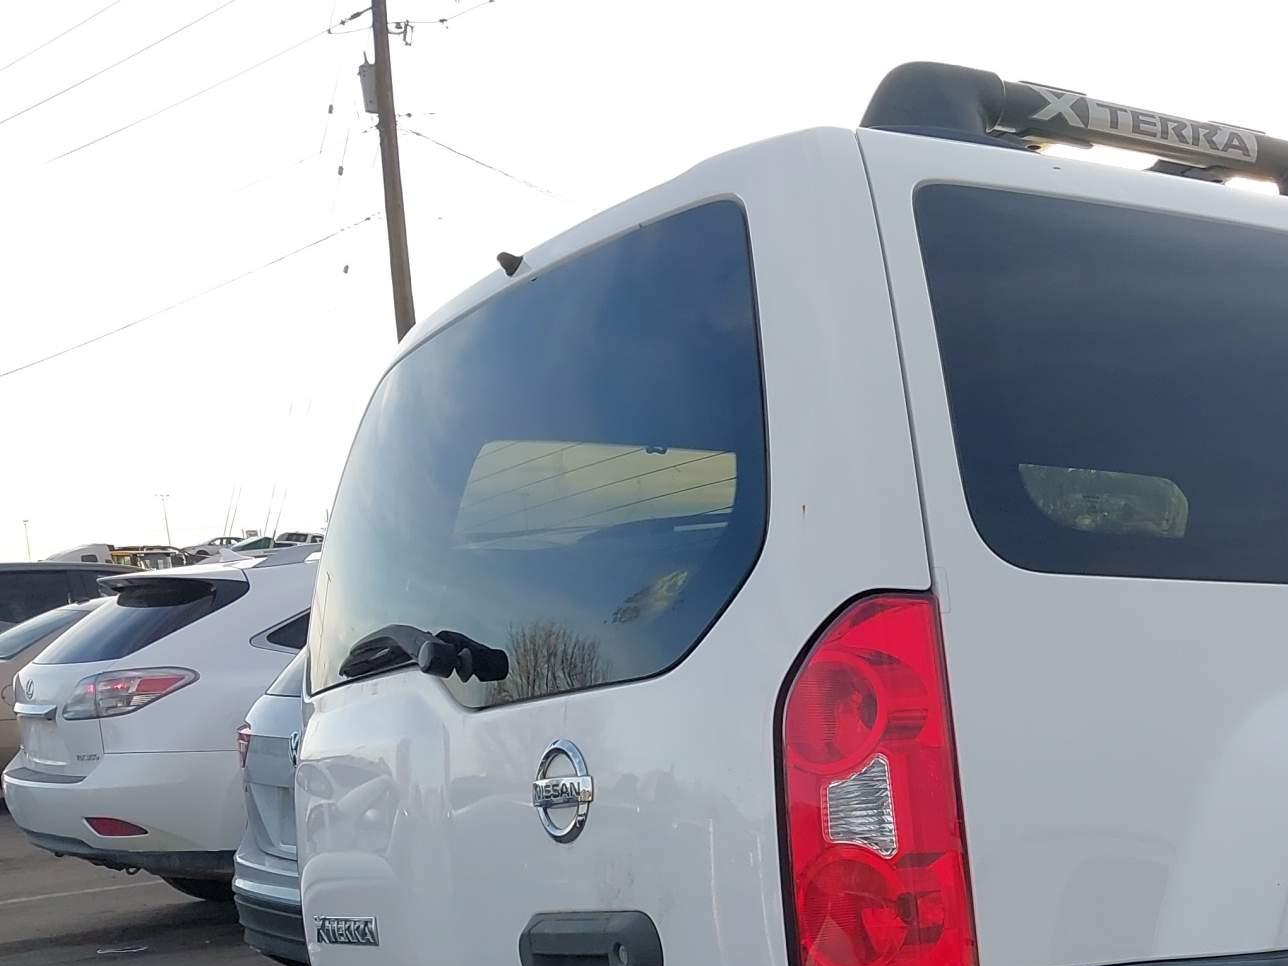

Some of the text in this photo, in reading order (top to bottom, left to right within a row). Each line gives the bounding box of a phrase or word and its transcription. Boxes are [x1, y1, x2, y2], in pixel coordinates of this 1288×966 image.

[1027, 83, 1254, 159] XTERRA
[533, 782, 581, 801] NISSAN
[313, 916, 379, 946] XTERRA
